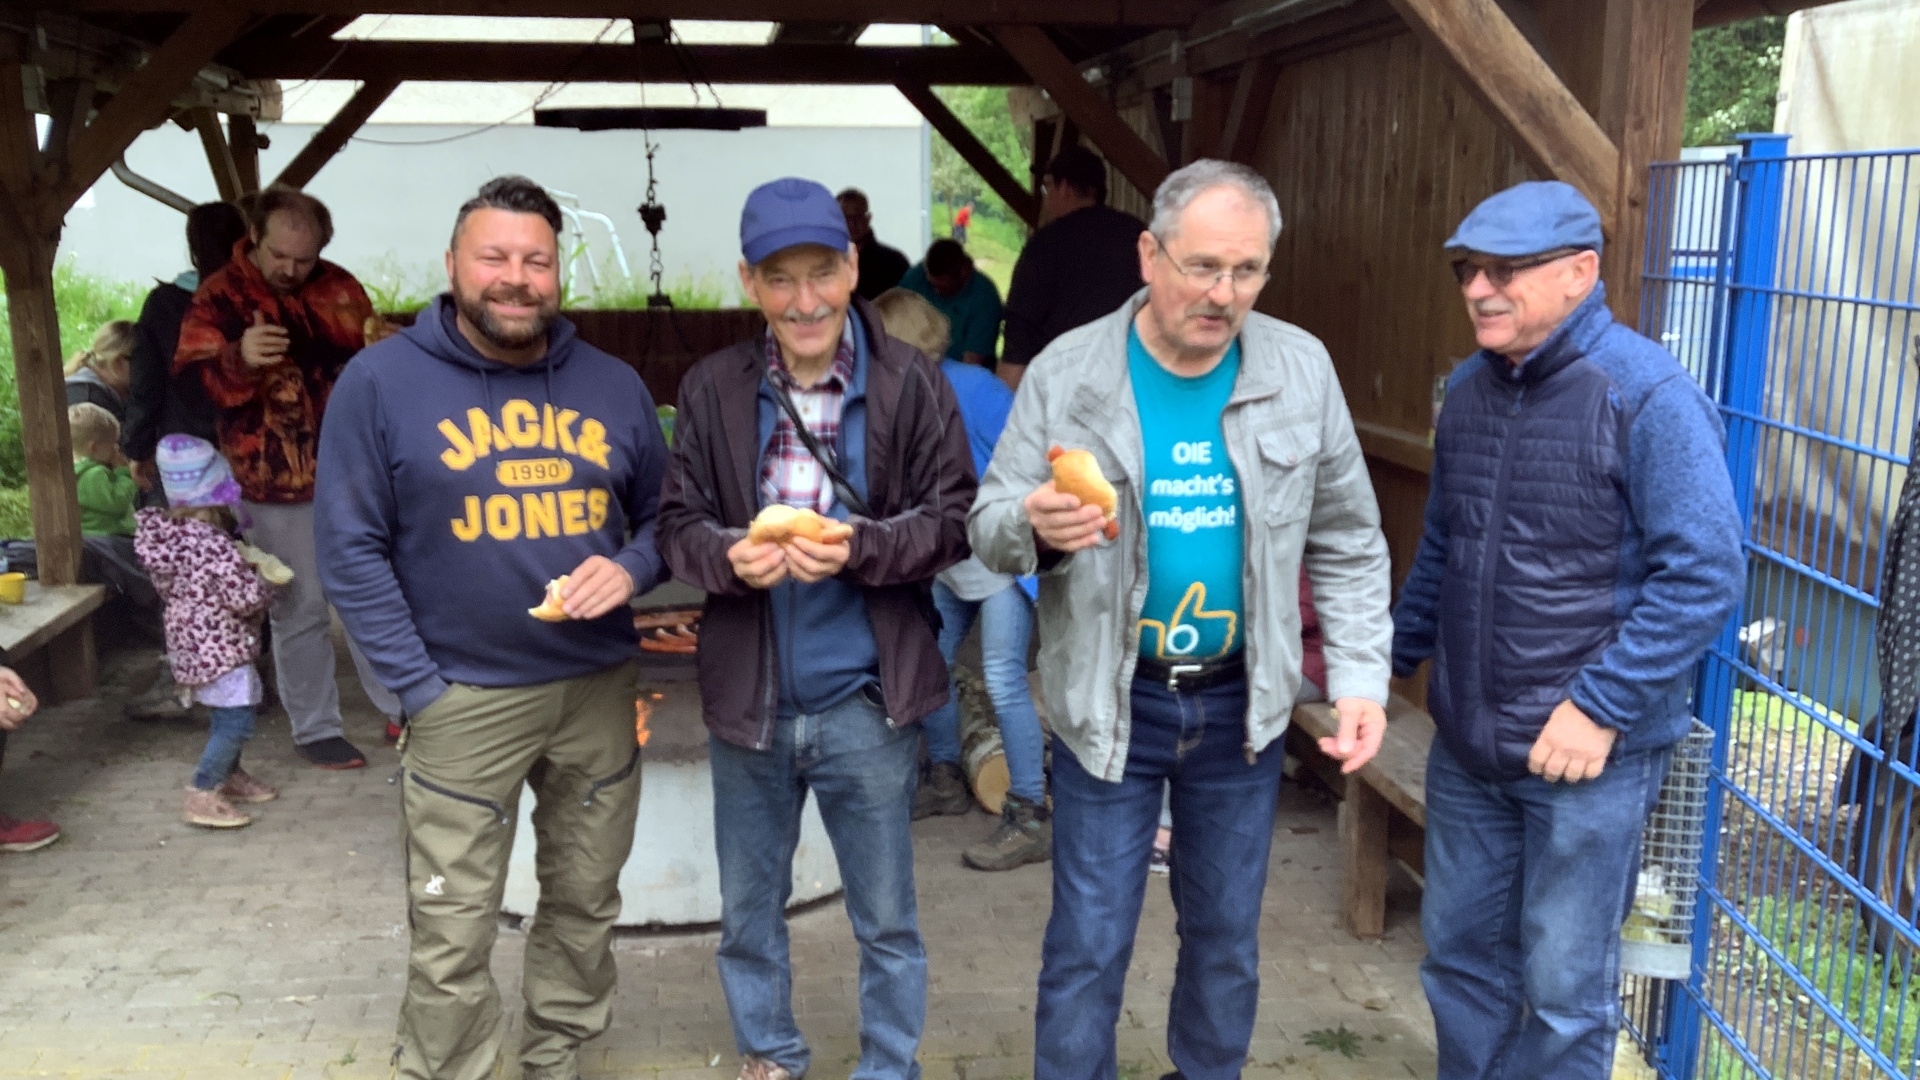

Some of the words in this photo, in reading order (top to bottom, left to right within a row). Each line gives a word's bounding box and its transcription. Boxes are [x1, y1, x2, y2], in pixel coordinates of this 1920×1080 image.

[1172, 441, 1212, 465] OIE
[511, 462, 560, 481] 1990
[1150, 473, 1235, 497] macht's
[450, 488, 610, 542] JONES
[1149, 504, 1236, 533] möglich!
